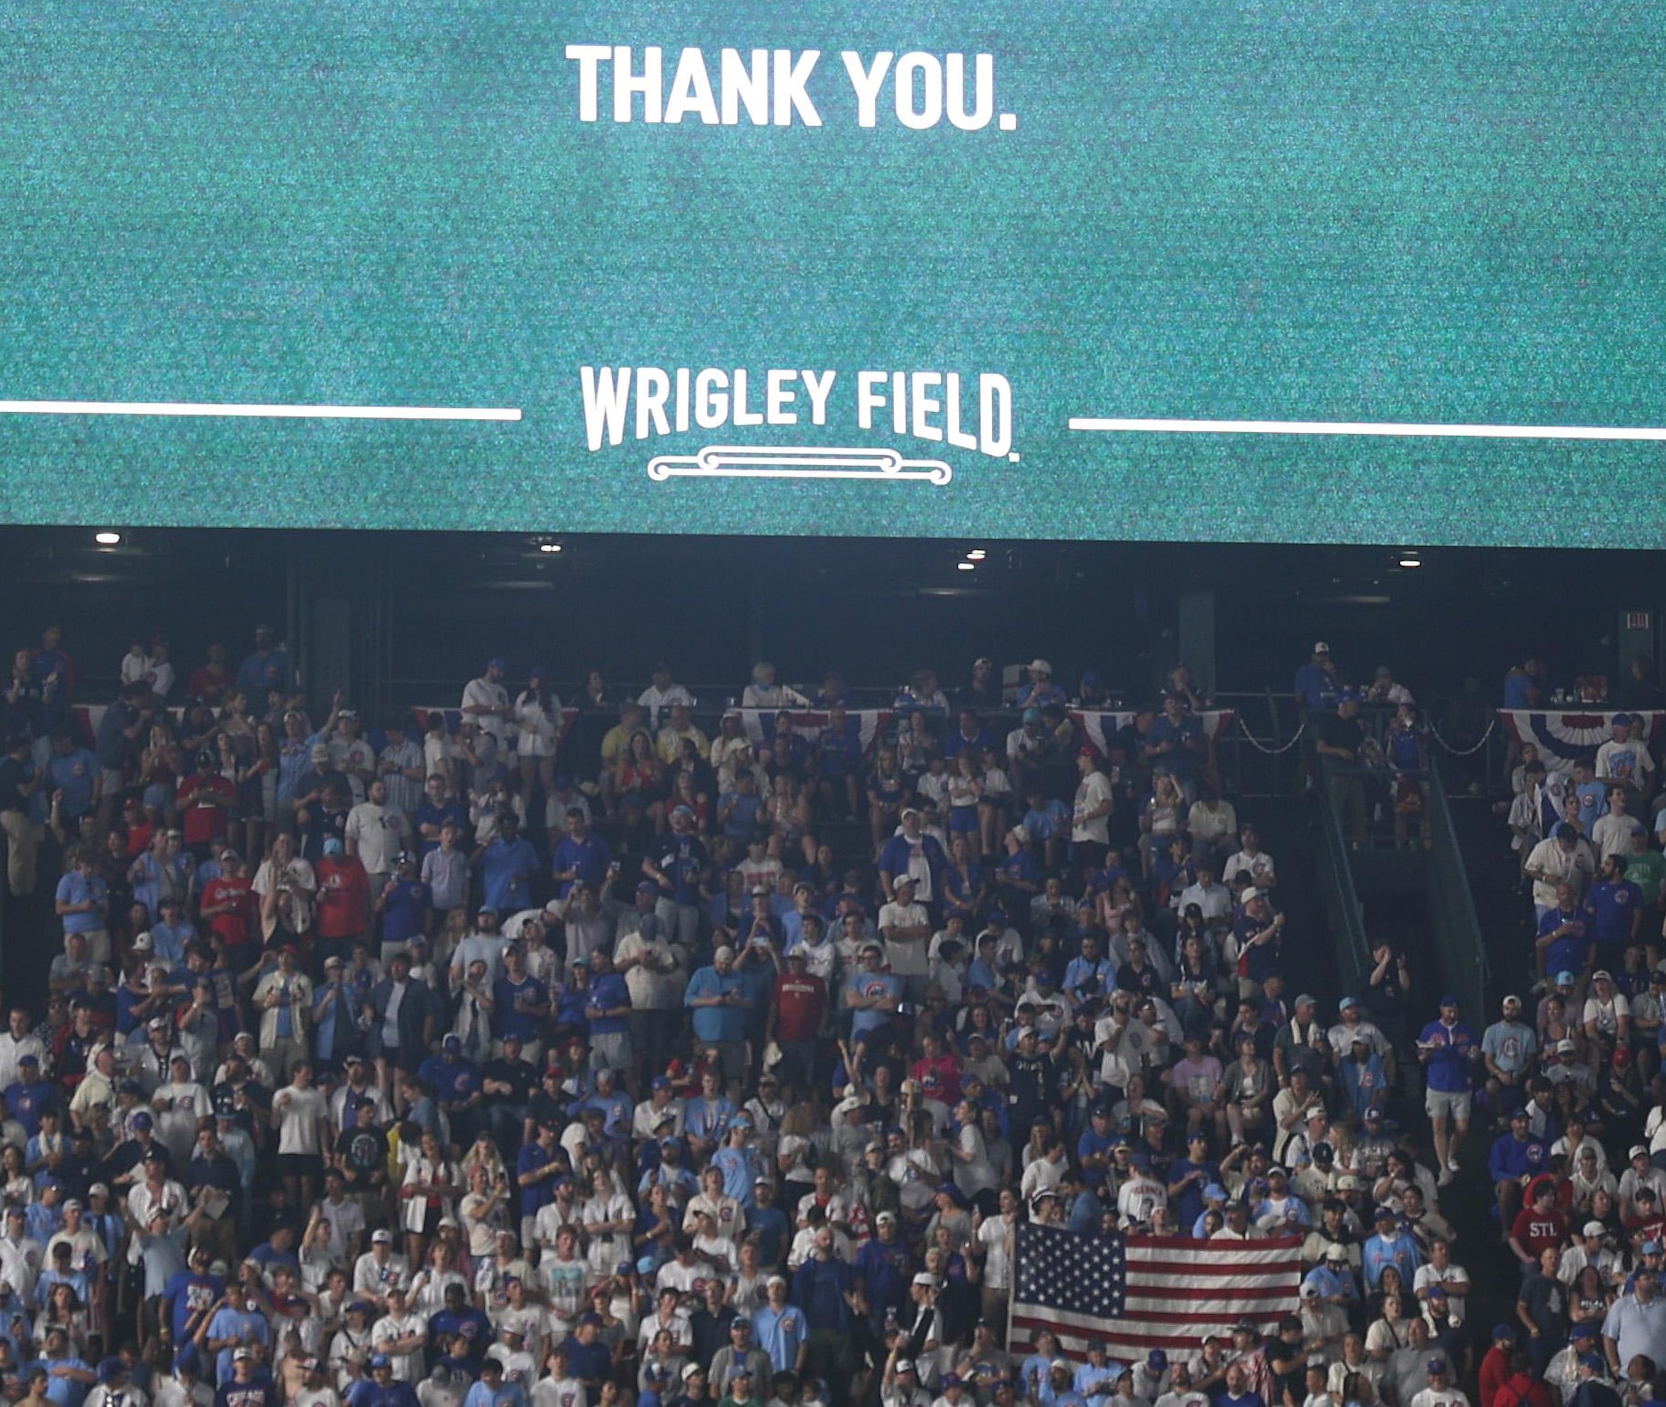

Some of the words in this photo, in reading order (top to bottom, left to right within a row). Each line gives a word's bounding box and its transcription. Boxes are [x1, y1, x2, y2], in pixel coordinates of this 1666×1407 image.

[565, 44, 823, 127] THANK
[840, 50, 1017, 131] YOU.
[580, 366, 836, 452] WRIGLEY
[857, 370, 1013, 458] FIELD
[1529, 1221, 1558, 1238] STL
